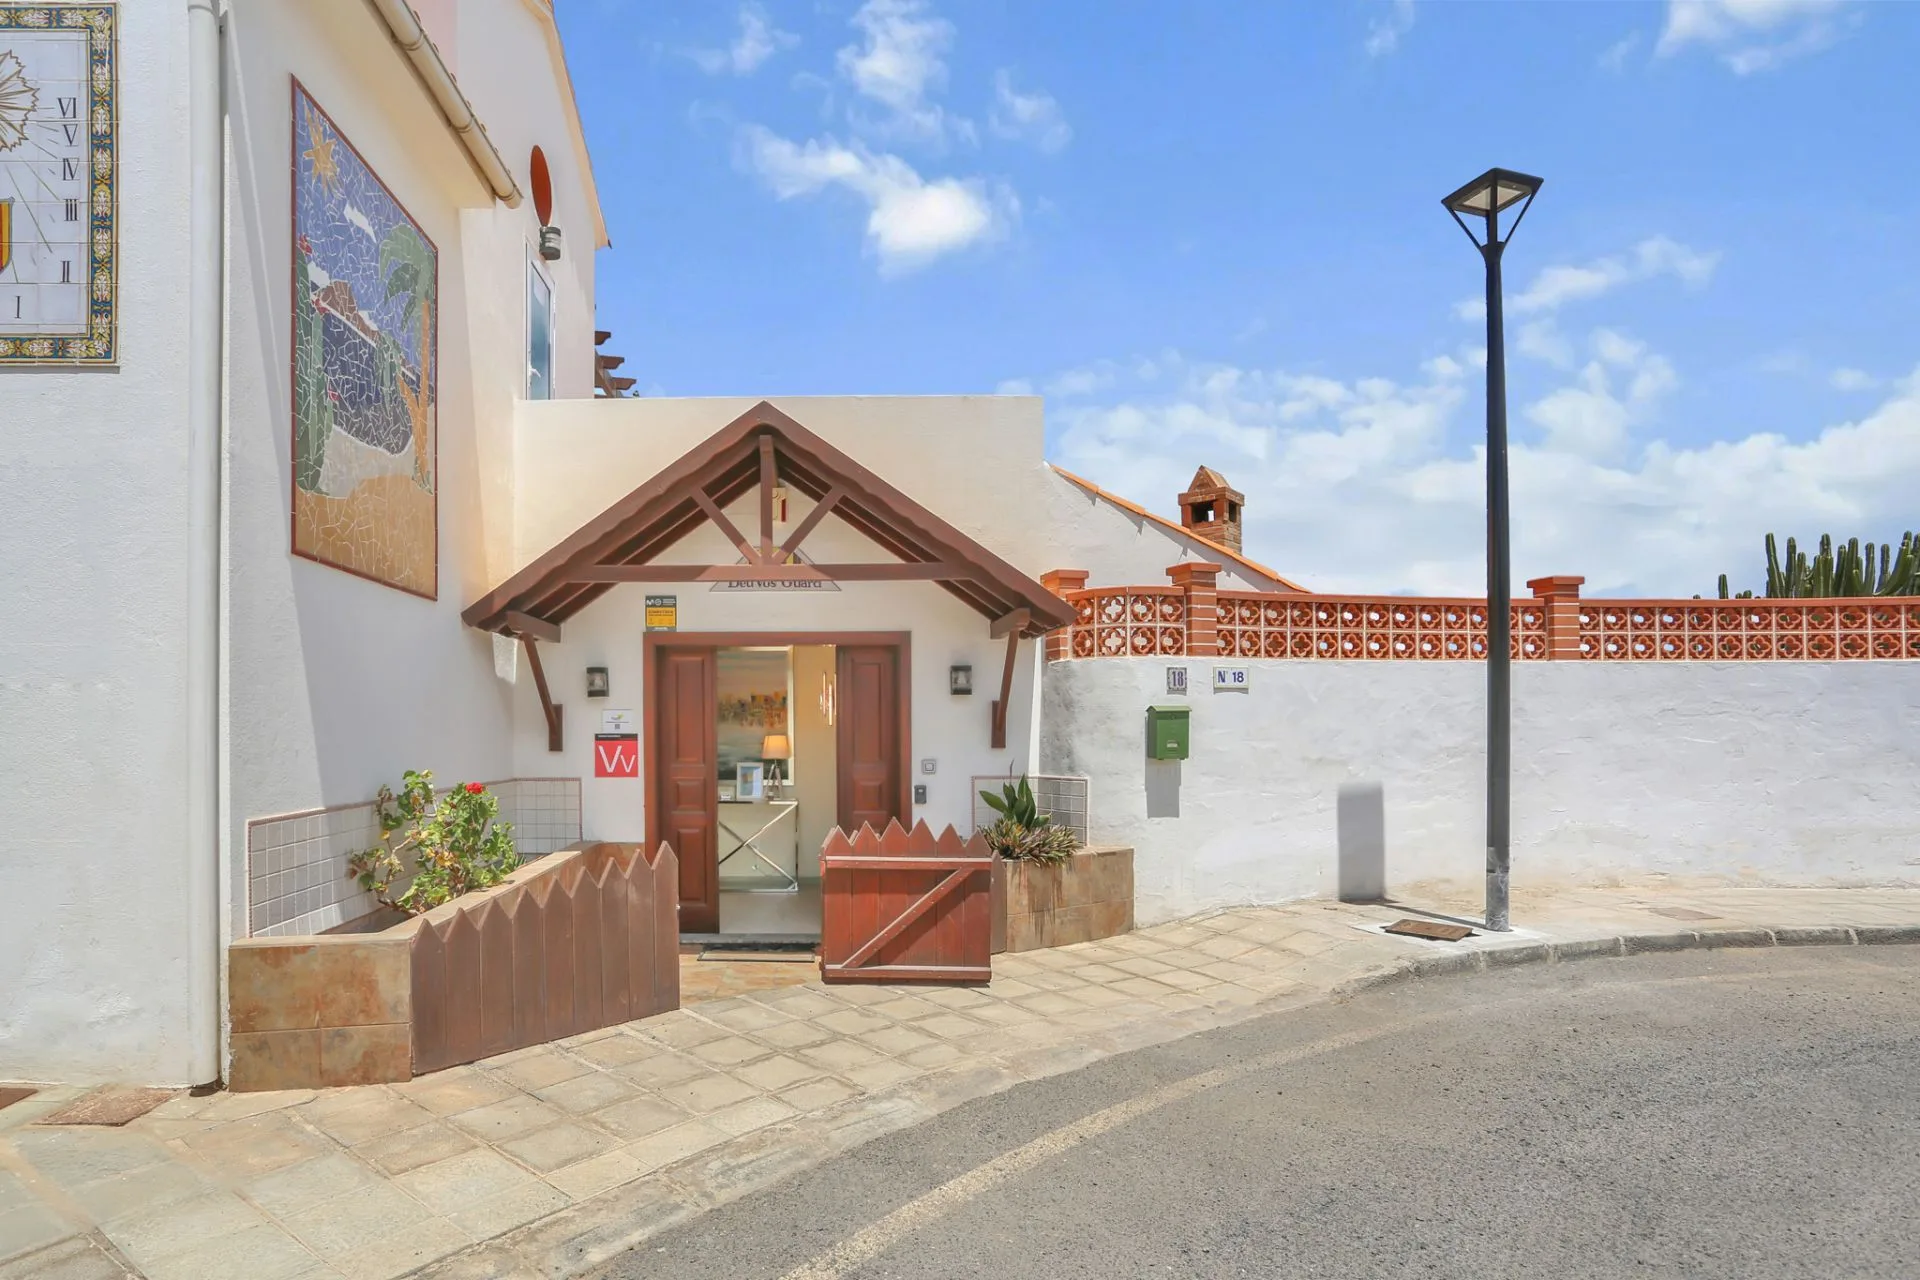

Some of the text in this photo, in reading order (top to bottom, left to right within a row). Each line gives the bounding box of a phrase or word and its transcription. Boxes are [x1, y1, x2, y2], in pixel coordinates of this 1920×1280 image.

[57, 96, 77, 119] VI
[62, 123, 78, 147] V
[62, 157, 80, 181] IV
[64, 198, 79, 222] III
[60, 260, 71, 283] II
[1172, 671, 1184, 687] 18
[1232, 671, 1244, 683] 18
